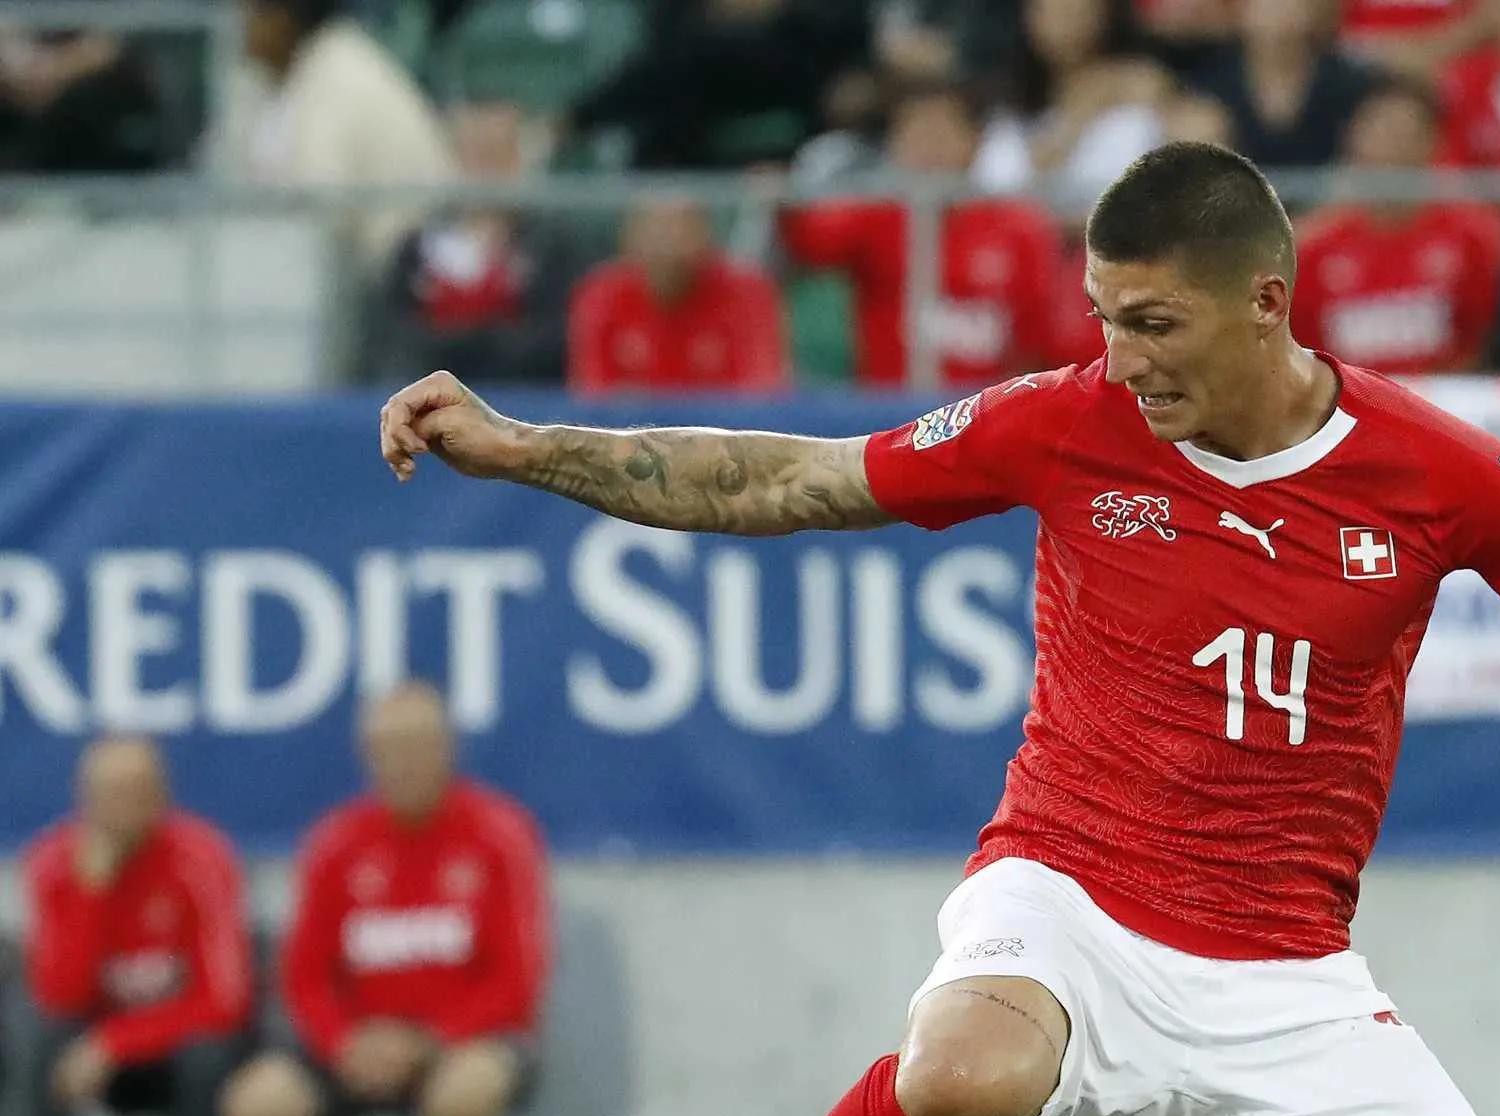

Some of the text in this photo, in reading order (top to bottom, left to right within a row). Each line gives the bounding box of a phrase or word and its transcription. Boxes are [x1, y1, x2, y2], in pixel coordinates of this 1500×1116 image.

[0, 516, 1032, 735] REDIT SUIS
[1191, 626, 1311, 746] 14
